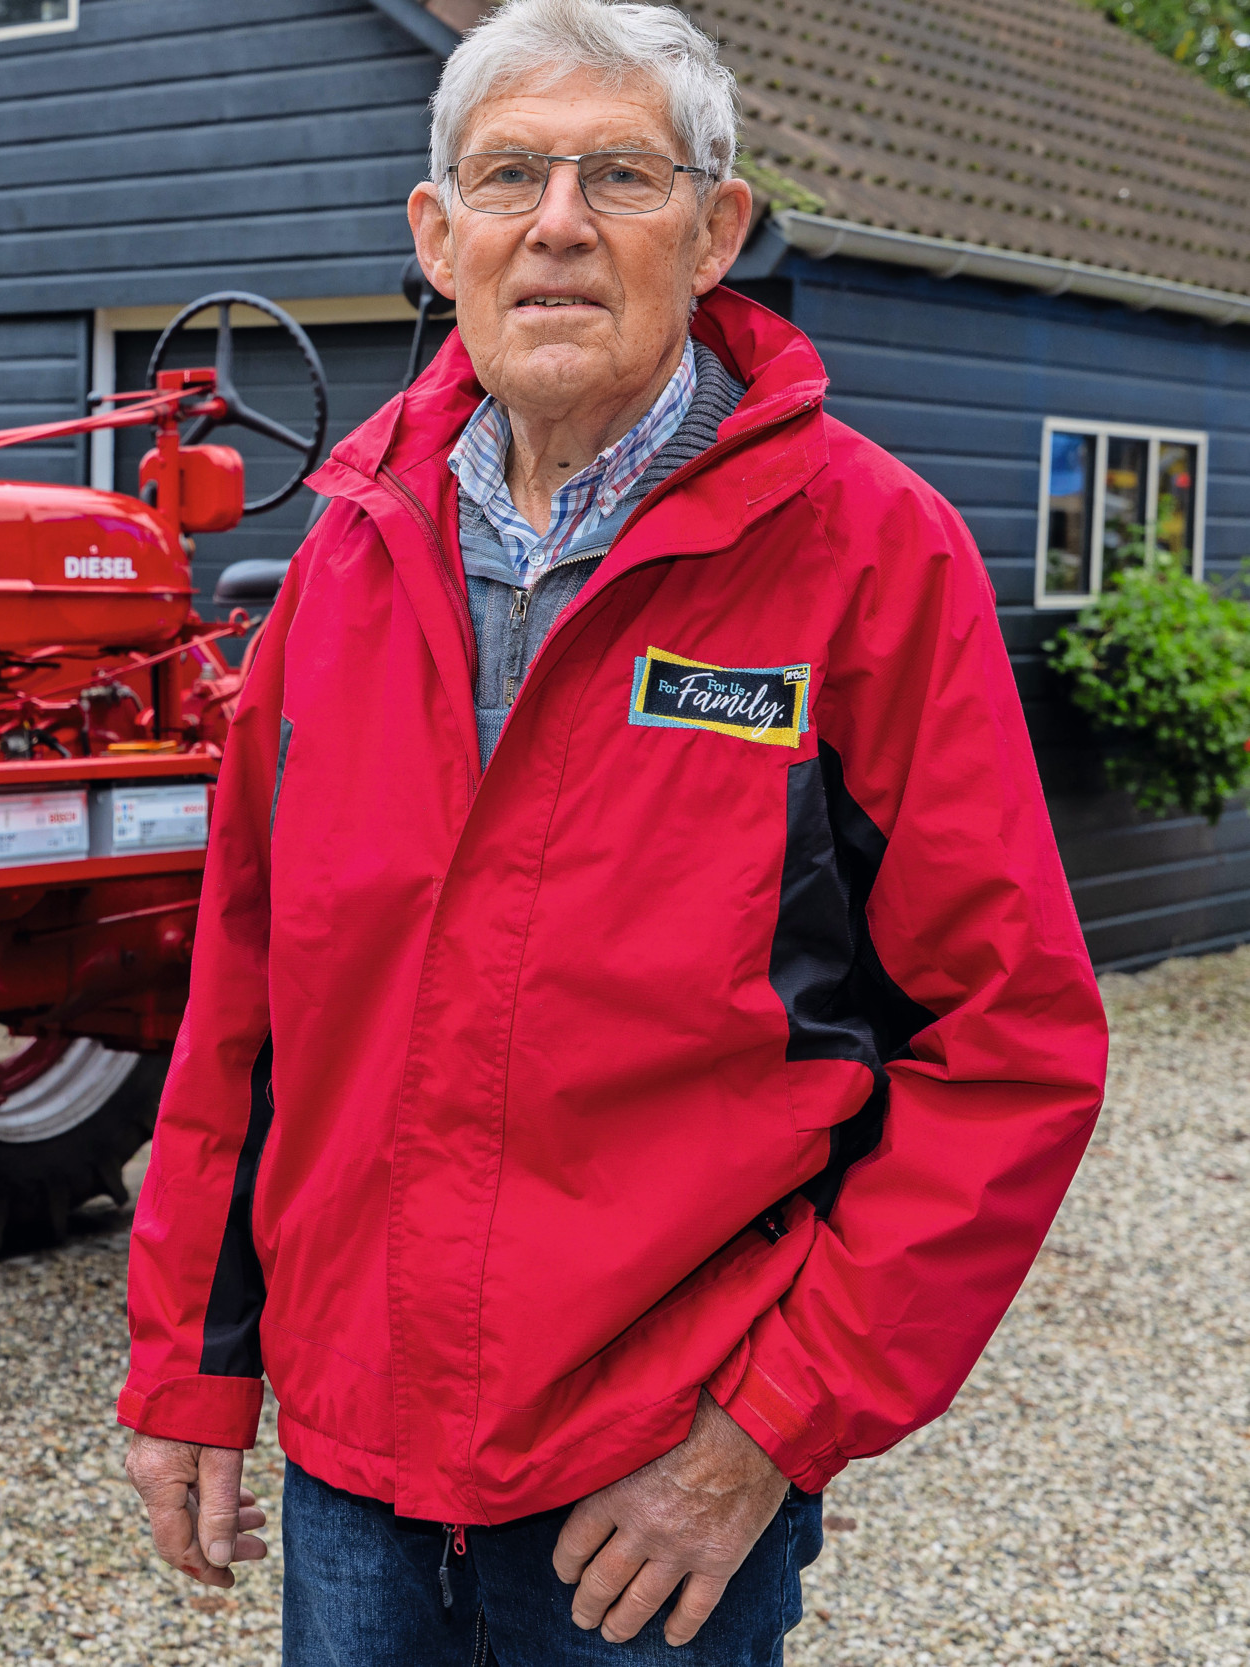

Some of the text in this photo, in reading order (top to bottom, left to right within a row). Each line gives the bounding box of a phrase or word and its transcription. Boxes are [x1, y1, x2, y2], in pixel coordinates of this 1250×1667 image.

[64, 555, 138, 580] DIESEL
[658, 679, 679, 695] For
[707, 678, 746, 696] For Us
